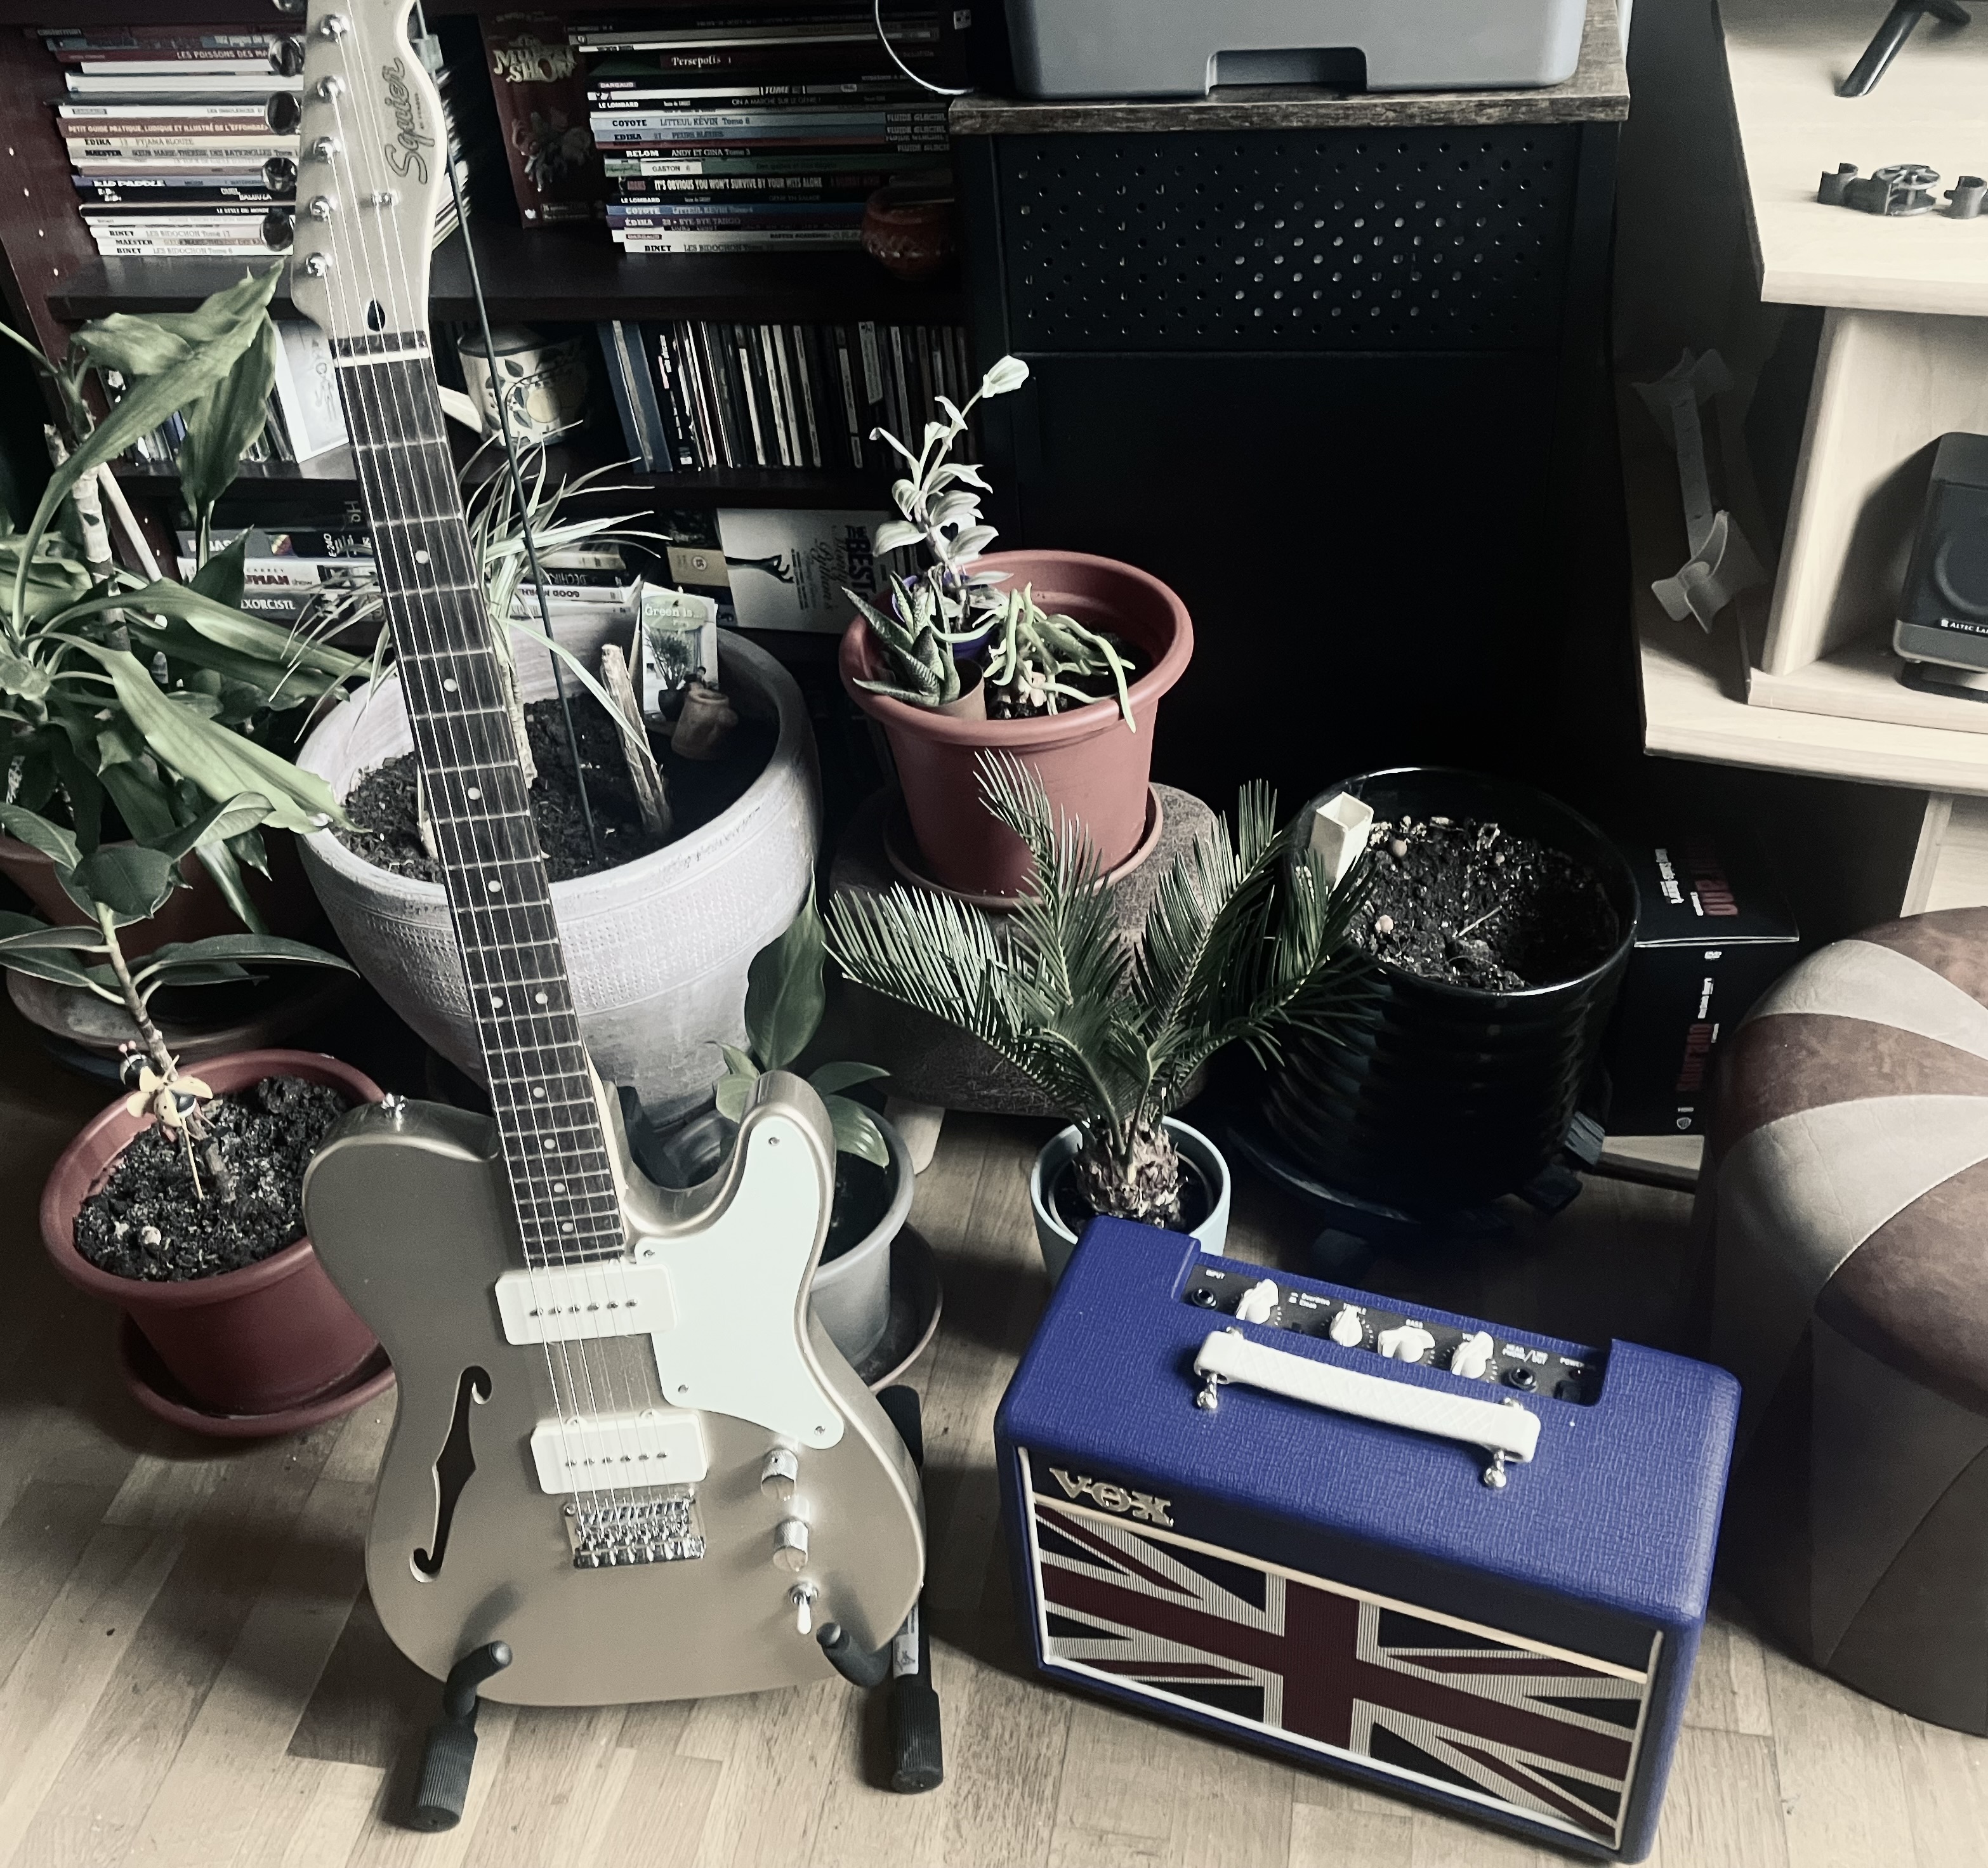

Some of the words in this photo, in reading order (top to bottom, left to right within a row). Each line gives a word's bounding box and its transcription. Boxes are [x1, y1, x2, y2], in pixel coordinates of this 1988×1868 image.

[177, 51, 192, 60] LES
[194, 50, 235, 60] POISSONS
[237, 50, 254, 59] DES
[671, 55, 721, 68] Persepolis
[382, 57, 435, 185] Squier
[660, 118, 692, 126] LITTEUL
[722, 117, 743, 126] Tome
[693, 148, 703, 157] ET
[704, 148, 723, 156] GINA
[724, 148, 744, 156] Tome
[654, 179, 667, 191] IT'S
[667, 179, 694, 190] OBVIOUS
[694, 179, 708, 190] YOU
[708, 178, 730, 190] WON'T
[730, 178, 757, 190] SURVIVE
[756, 178, 767, 189] BY
[767, 177, 786, 188] YOUR
[625, 206, 662, 215] COYOTE
[845, 539, 877, 594] BEST
[553, 589, 580, 598] GOOD
[645, 603, 680, 617] Green
[1949, 622, 1974, 631] ALTEC
[1049, 1467, 1174, 1527] VOX
